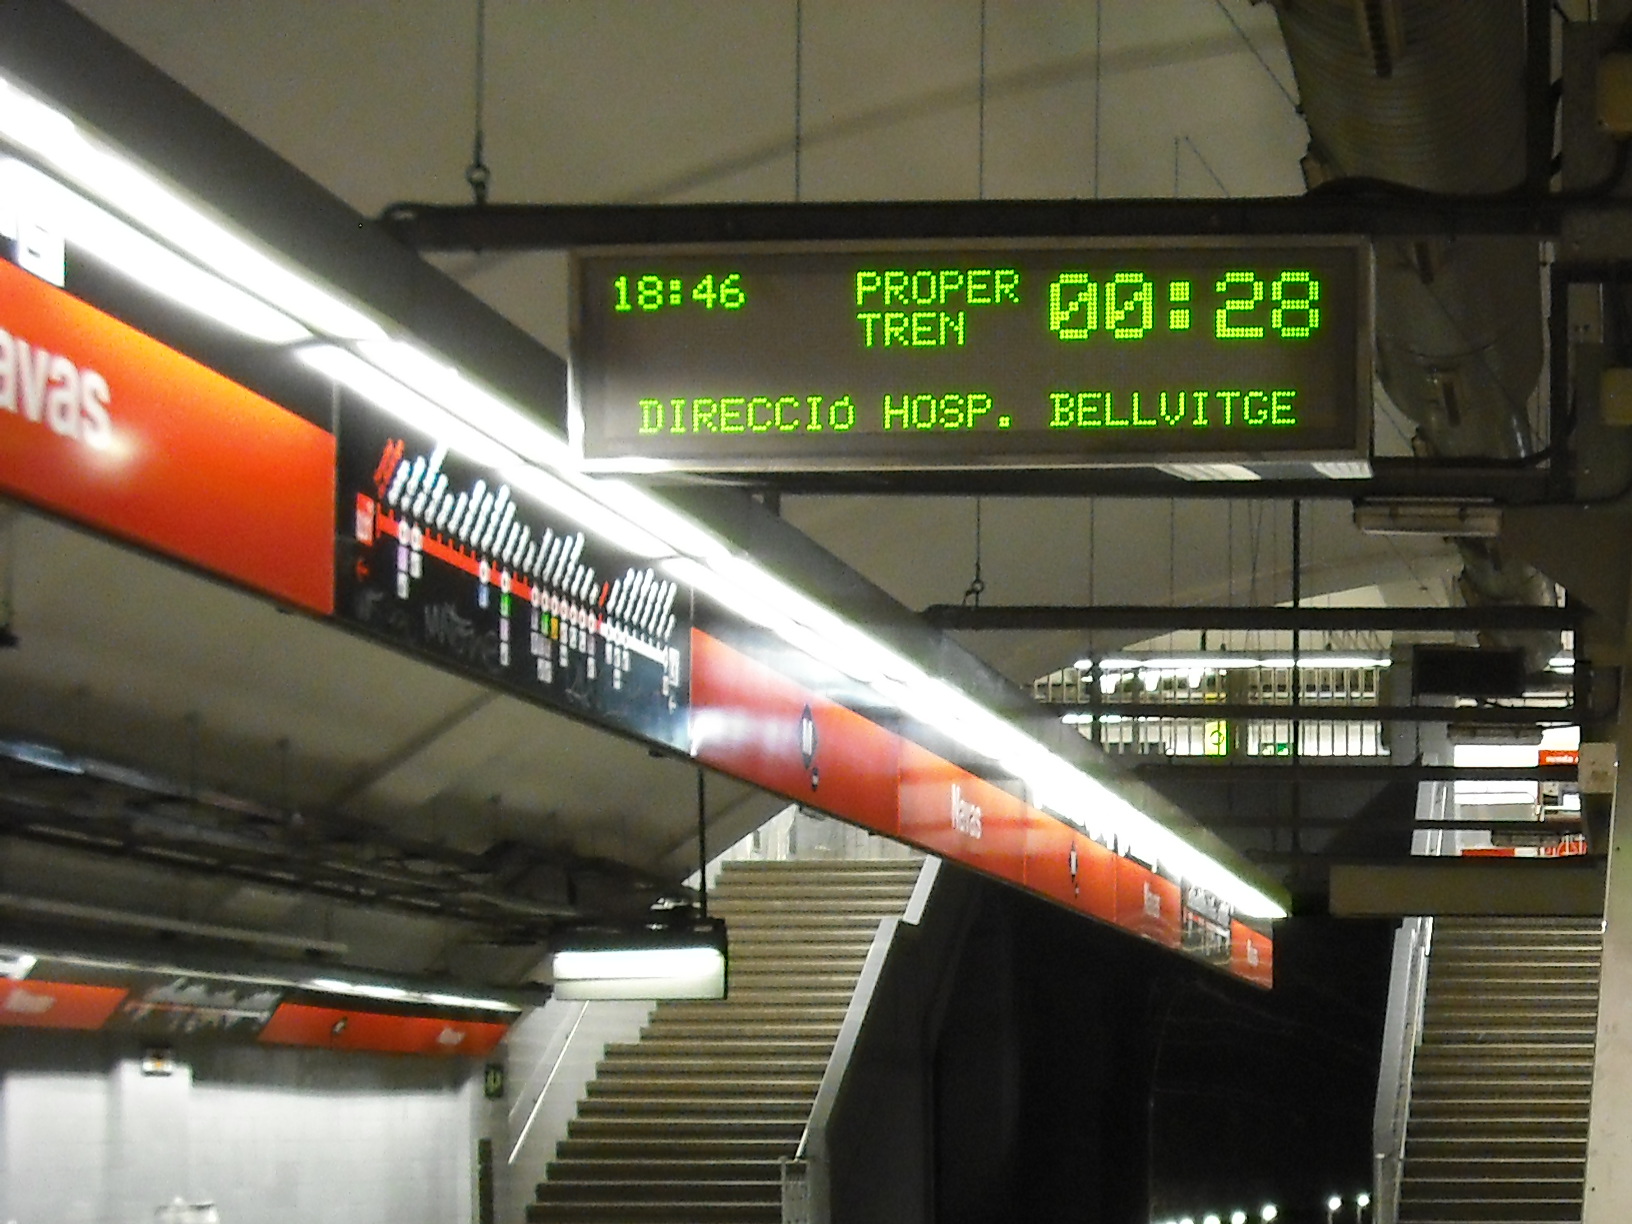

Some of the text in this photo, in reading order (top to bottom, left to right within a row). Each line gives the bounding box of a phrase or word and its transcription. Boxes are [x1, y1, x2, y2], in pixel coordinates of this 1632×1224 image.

[615, 274, 745, 311] 18:46
[856, 270, 1019, 306] PROPER
[1048, 271, 1319, 341] 00:28
[856, 311, 965, 347] TREN
[881, 393, 1012, 431] HOSP.
[1049, 390, 1297, 428] BELLVITGE
